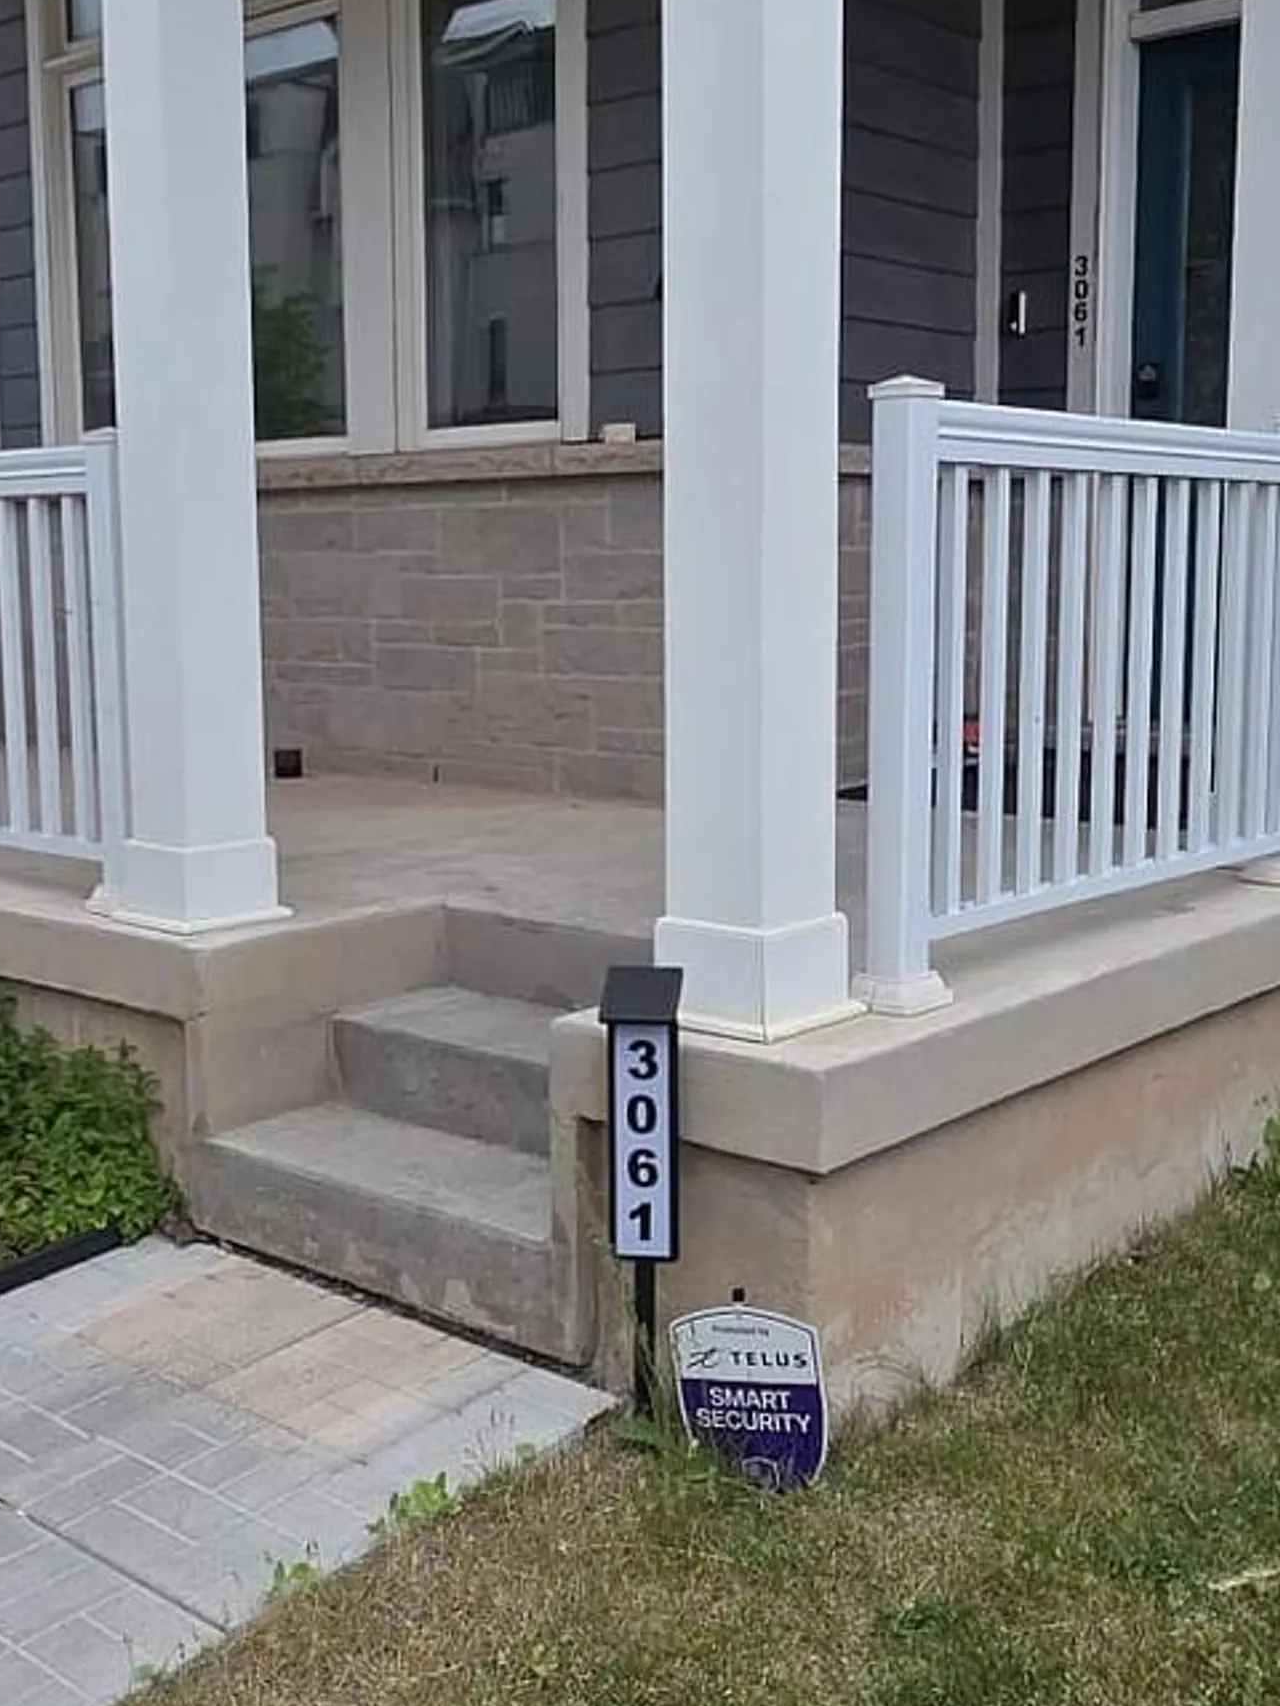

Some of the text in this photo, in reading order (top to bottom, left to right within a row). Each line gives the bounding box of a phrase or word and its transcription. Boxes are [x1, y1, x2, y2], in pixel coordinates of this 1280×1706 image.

[1073, 255, 1089, 347] 3061
[626, 1039, 660, 1242] 3061
[730, 1351, 807, 1368] TELUS
[708, 1386, 792, 1411] SMART
[695, 1407, 812, 1435] SECURITY
